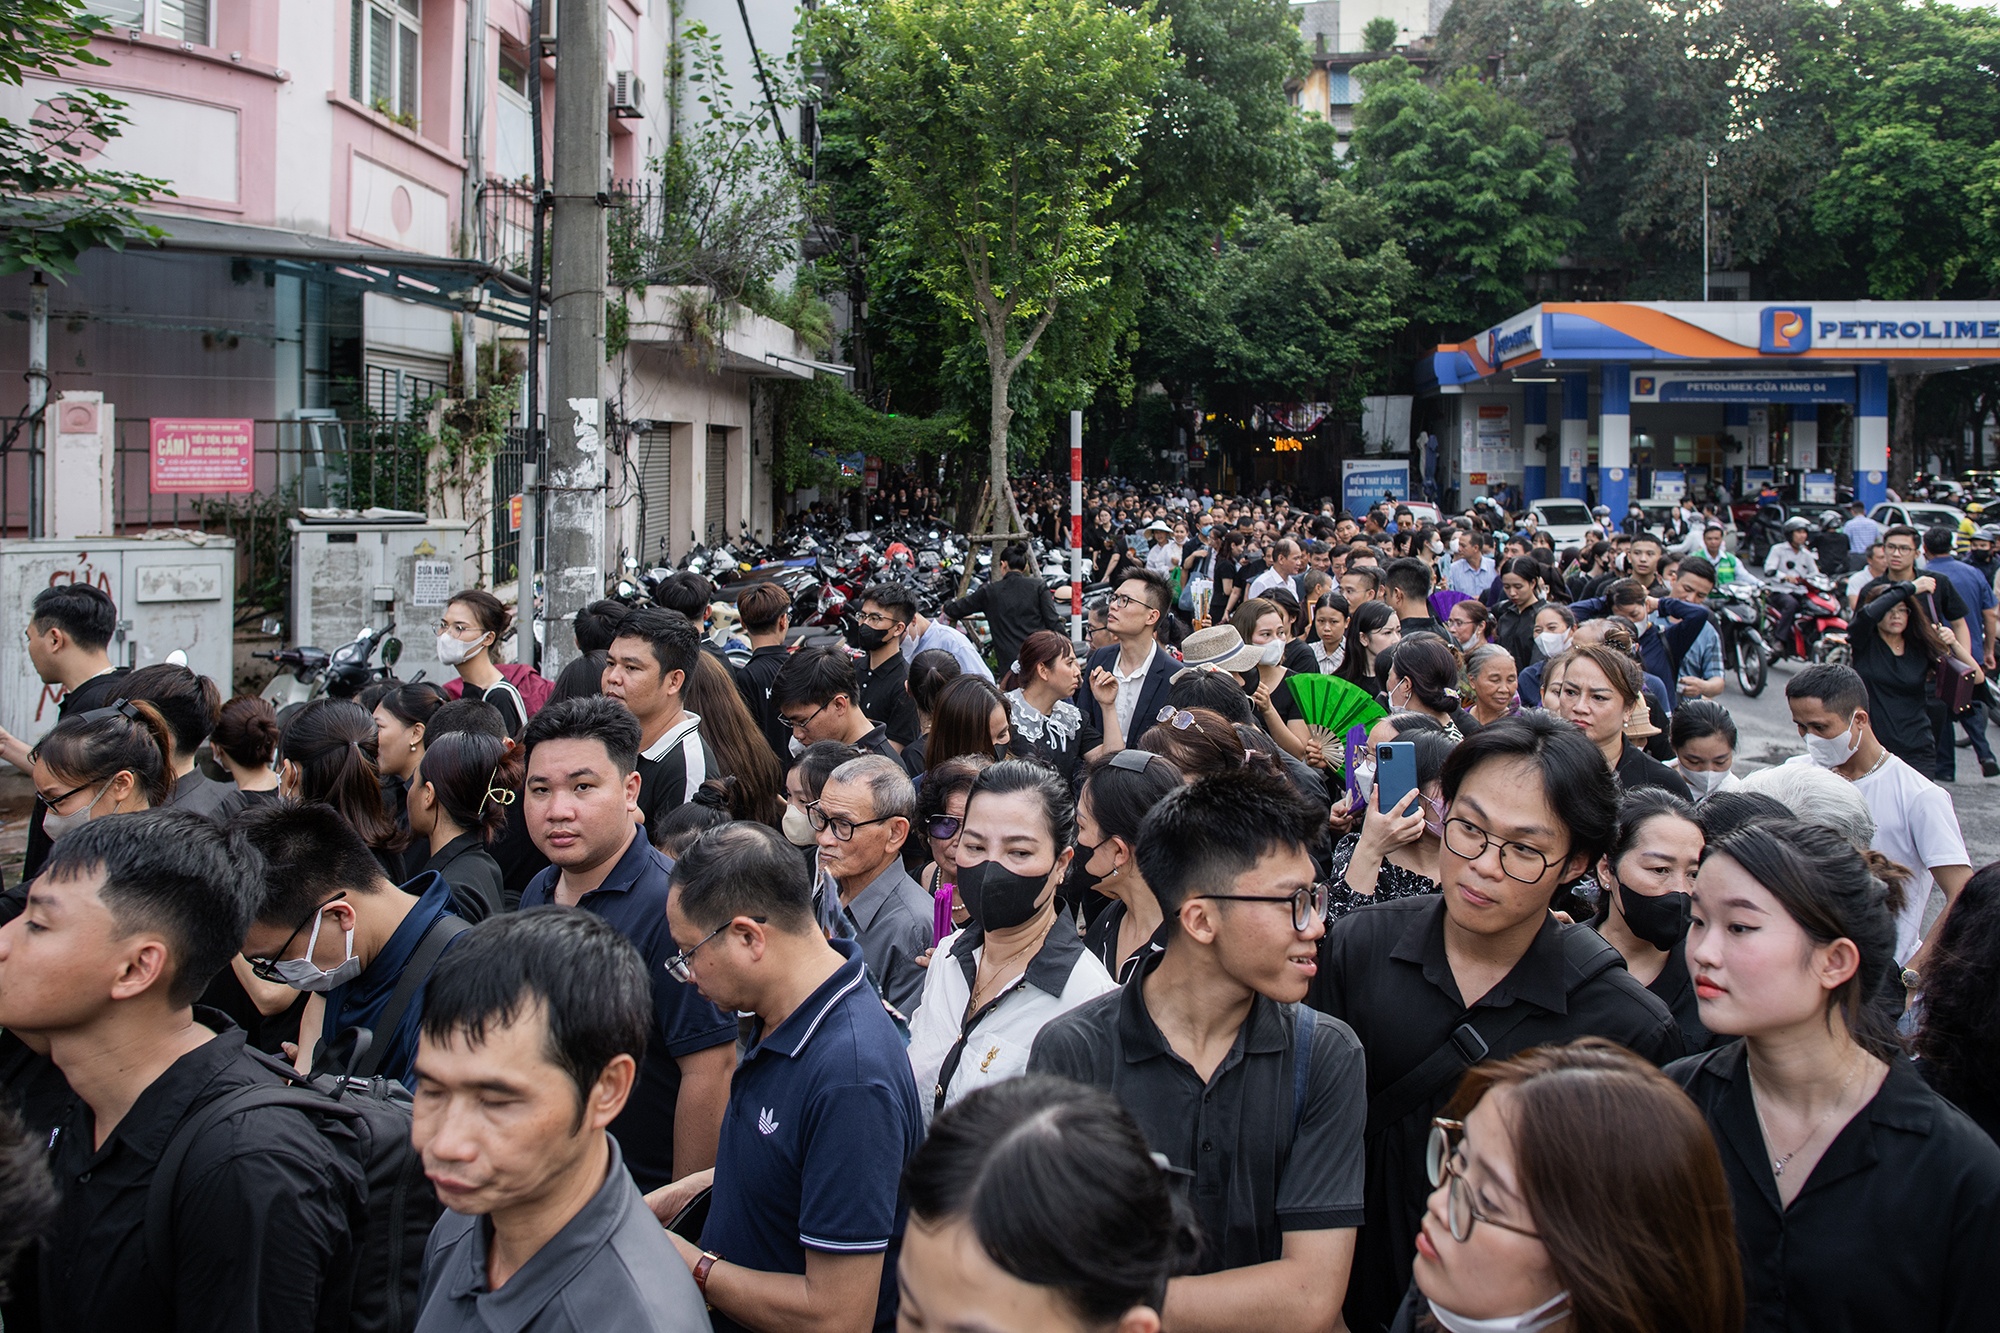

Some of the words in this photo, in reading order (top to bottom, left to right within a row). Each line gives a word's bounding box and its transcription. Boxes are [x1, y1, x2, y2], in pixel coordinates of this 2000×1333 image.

[1780, 382, 1811, 393] HÀNG
[1813, 384, 1826, 393] 04
[157, 433, 185, 456] CẤM
[204, 446, 220, 456] CÔNG
[1366, 477, 1379, 485] THAY
[1393, 477, 1401, 485] XE
[434, 564, 449, 575] NHÀ
